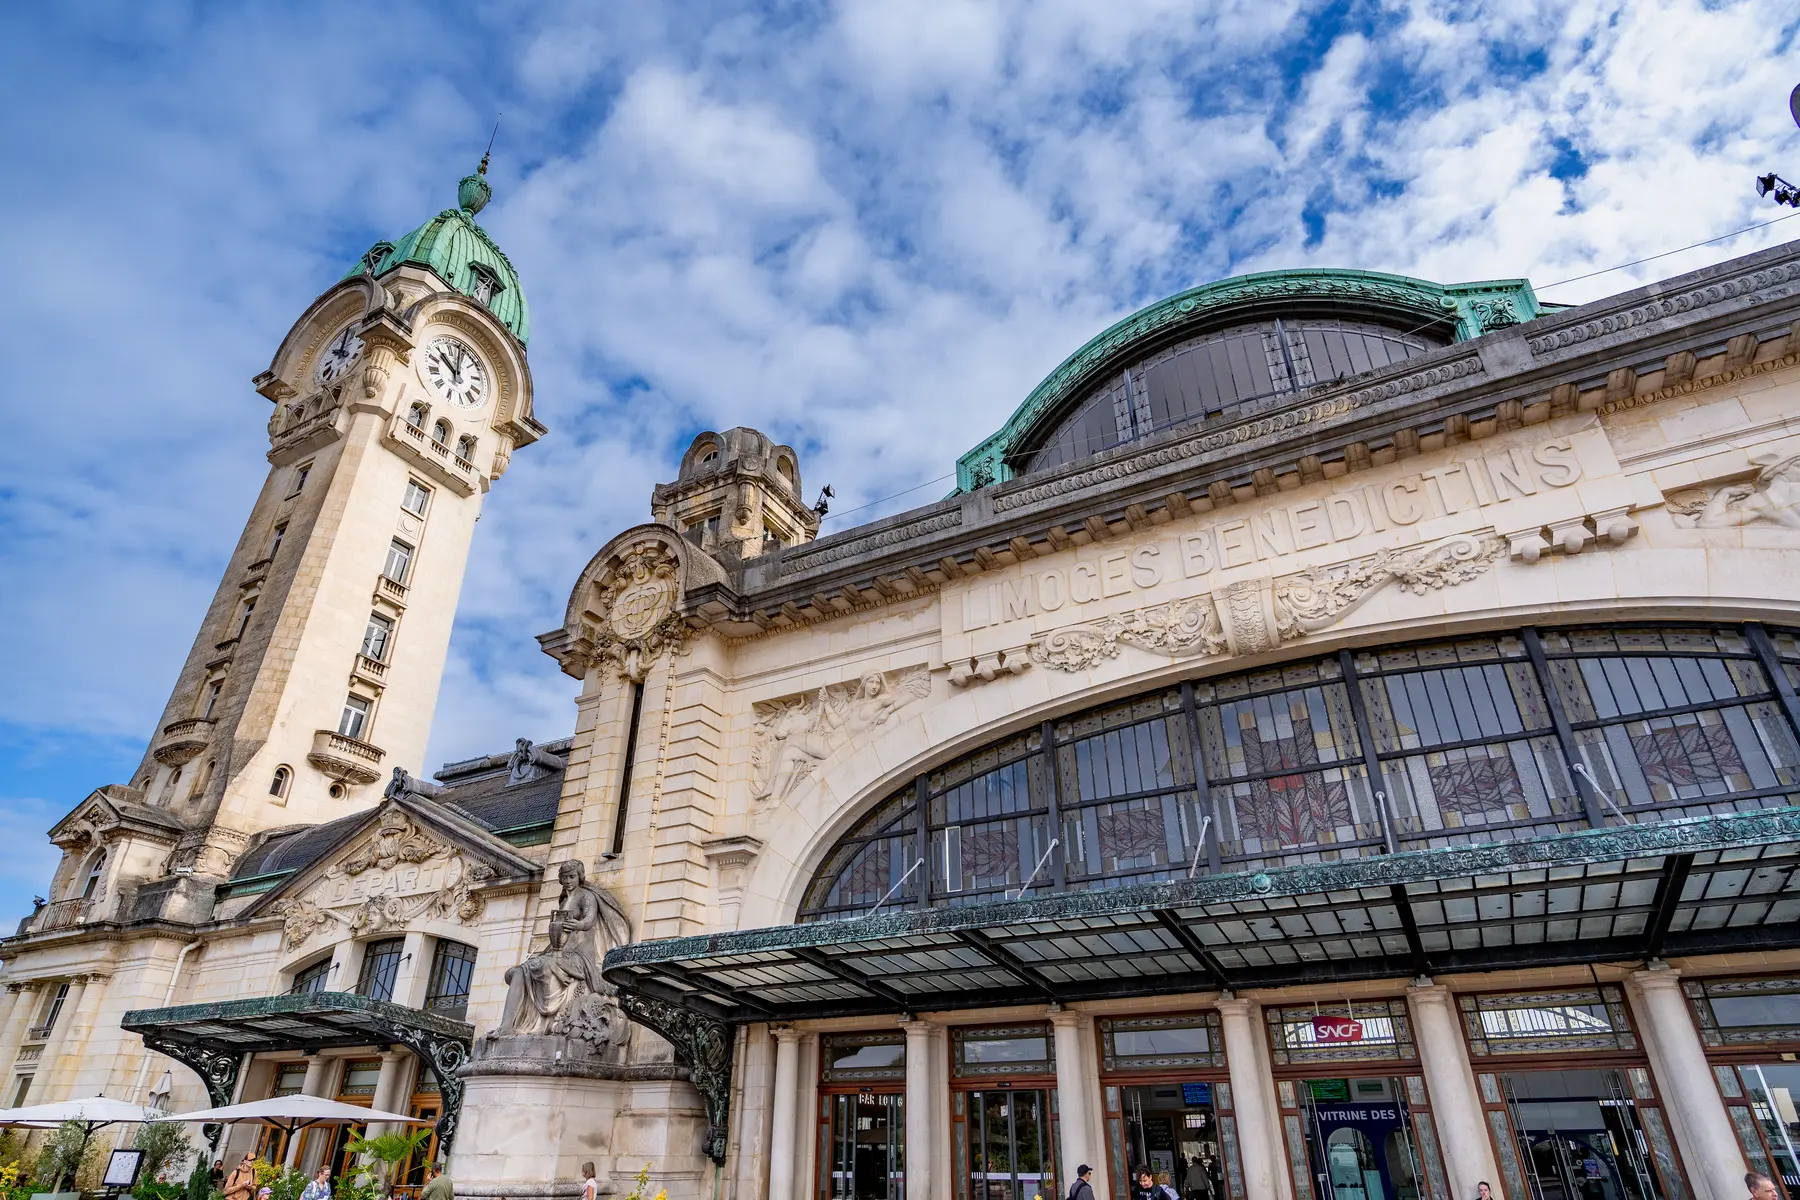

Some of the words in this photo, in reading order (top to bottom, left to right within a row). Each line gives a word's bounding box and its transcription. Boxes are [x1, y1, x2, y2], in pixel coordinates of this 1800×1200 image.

[961, 543, 1164, 633] LIMOGES
[1178, 437, 1582, 578] BENEDICTINS
[1317, 1023, 1360, 1038] SNCF
[1318, 1110, 1368, 1121] VITRINE
[1371, 1109, 1396, 1120] DES
